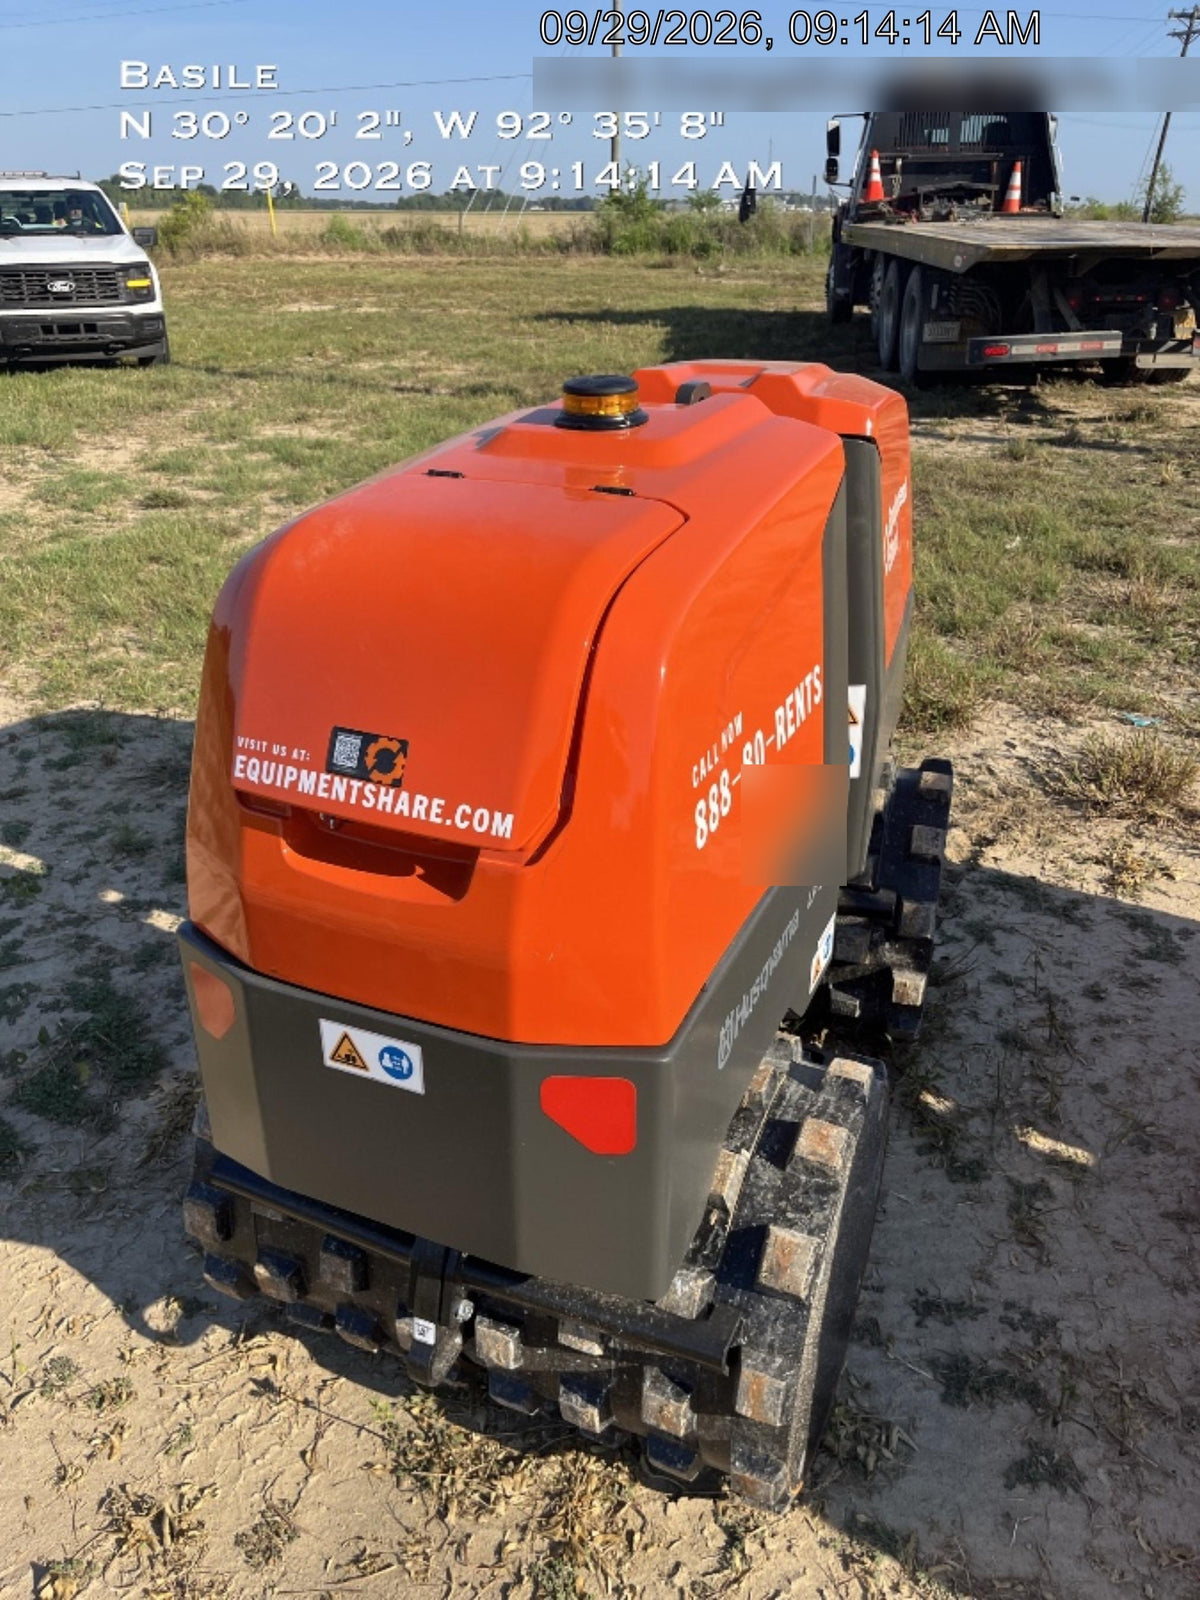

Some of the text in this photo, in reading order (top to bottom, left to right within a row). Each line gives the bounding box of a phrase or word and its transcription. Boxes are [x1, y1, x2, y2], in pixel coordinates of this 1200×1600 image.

[236, 735, 311, 762] VISIT US AT:
[692, 711, 743, 789] CALL NOW
[233, 754, 515, 839] EQUIPMENTSHARE.COM
